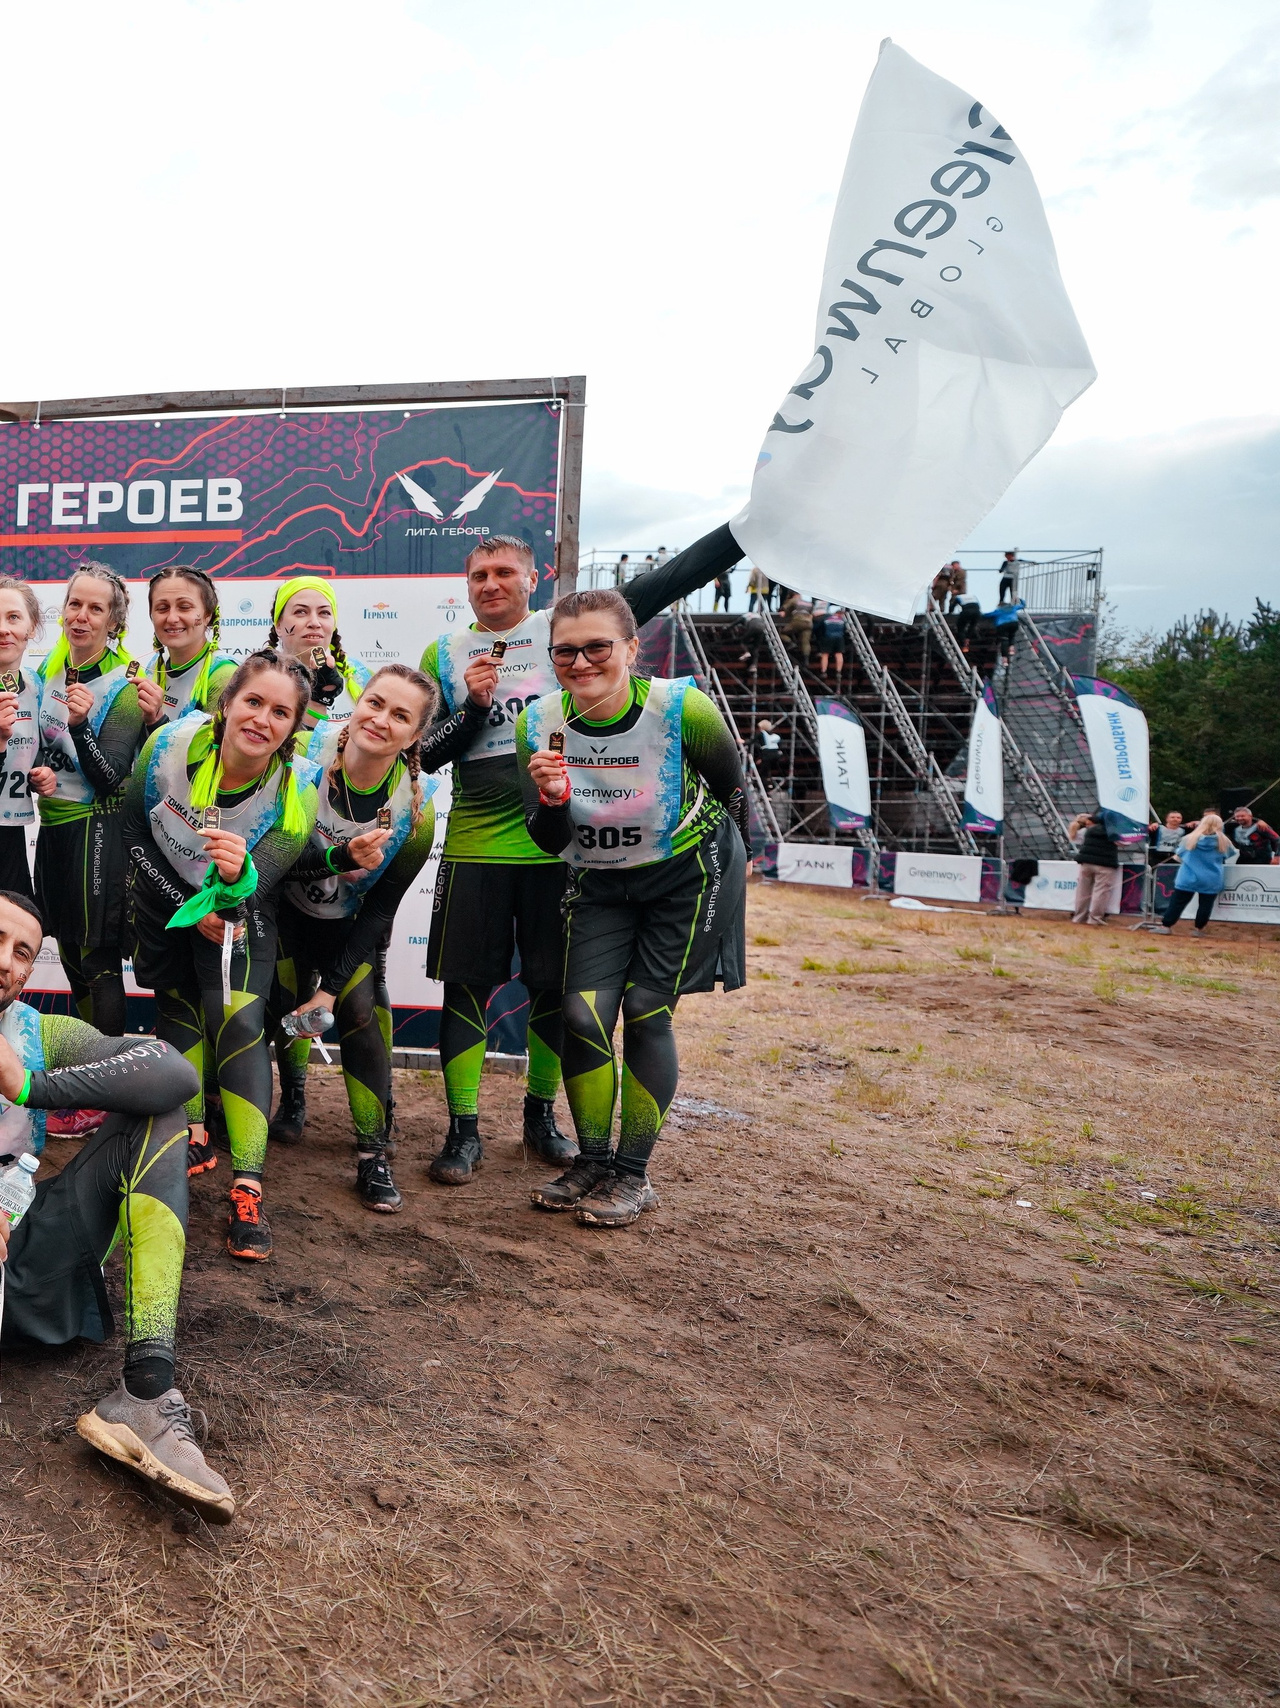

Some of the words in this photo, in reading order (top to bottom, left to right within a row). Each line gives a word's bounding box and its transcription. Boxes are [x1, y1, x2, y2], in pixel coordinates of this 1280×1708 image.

[16, 477, 244, 527] ГЕРОЕВ
[404, 527, 438, 537] ЛИГА
[441, 526, 490, 536] ГЕРОЕВ
[220, 618, 273, 627] АЗПРОМБАН
[83, 728, 120, 786] Greenway
[597, 756, 640, 765] ГЕРОЕВ
[570, 788, 633, 801] eenway
[575, 824, 642, 849] 305
[795, 859, 835, 870] TANK
[130, 846, 186, 907] Greenway
[909, 867, 960, 882] Greenway
[1222, 893, 1259, 902] AHMAD
[1260, 894, 1279, 903] TEA
[88, 1063, 150, 1079] GLOBAL
